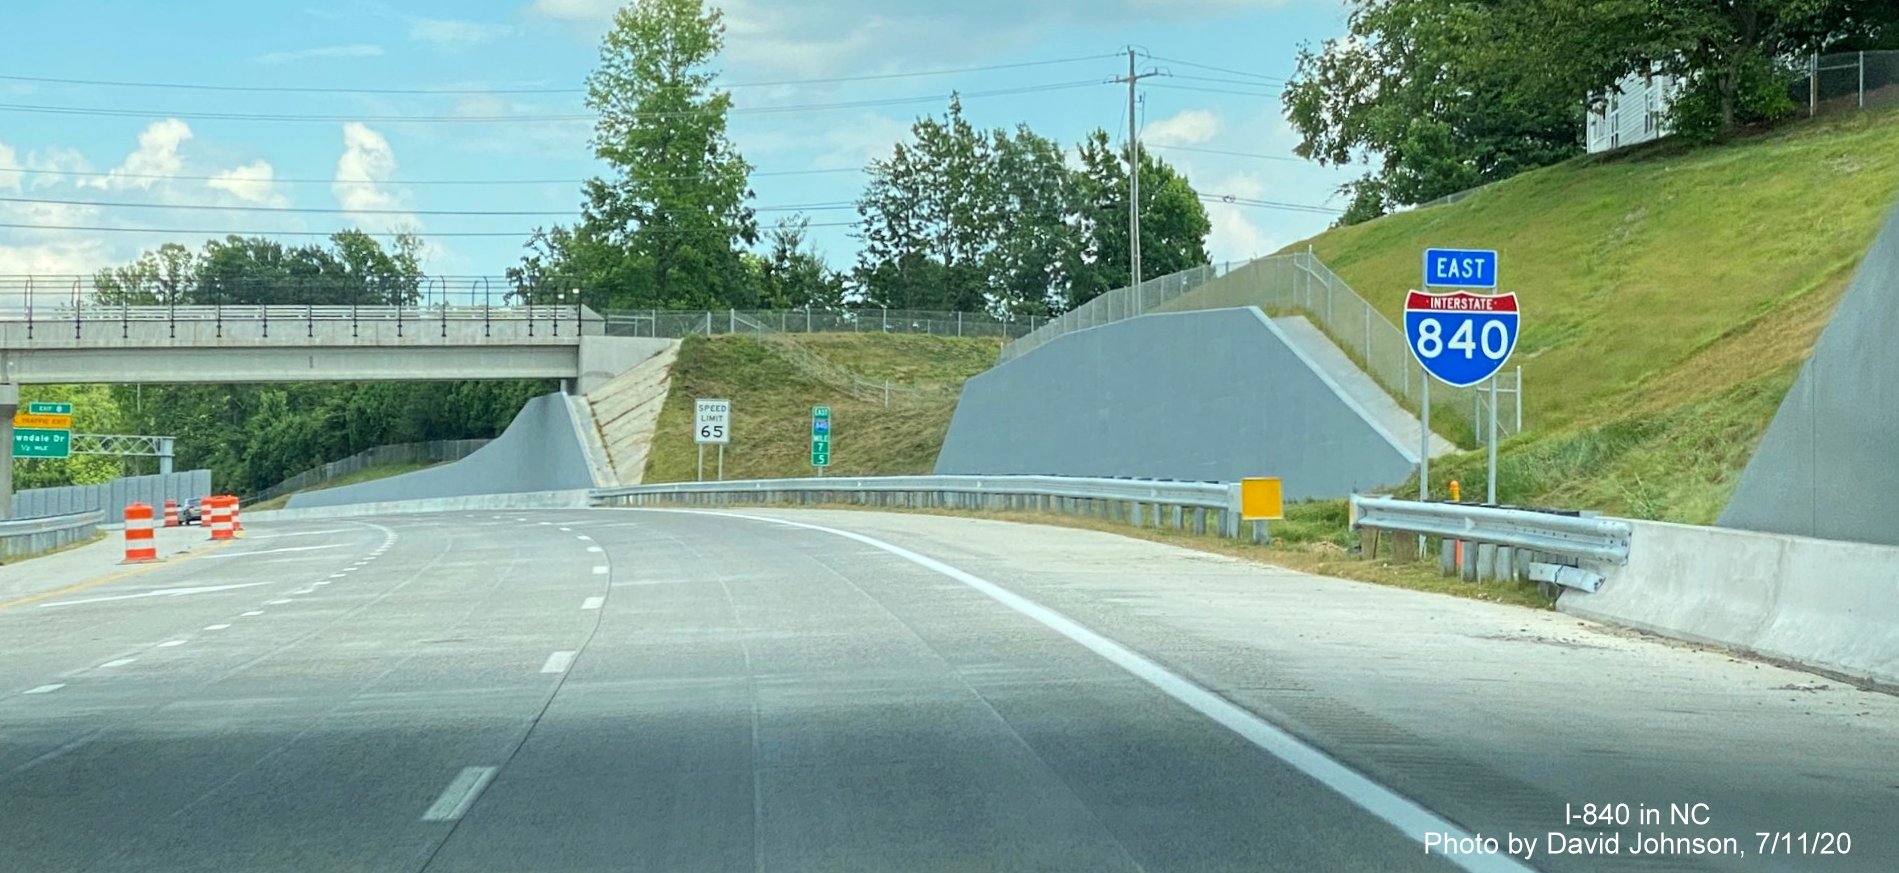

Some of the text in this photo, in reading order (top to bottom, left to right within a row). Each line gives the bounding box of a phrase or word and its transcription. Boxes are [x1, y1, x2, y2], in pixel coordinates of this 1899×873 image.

[1437, 257, 1485, 279] EAST
[1430, 297, 1493, 310] INTERSTATE
[1417, 318, 1508, 360] 840
[699, 404, 727, 412] SPEED
[15, 434, 65, 442] wndale Dr
[701, 425, 723, 438] 65
[817, 442, 824, 452] 7
